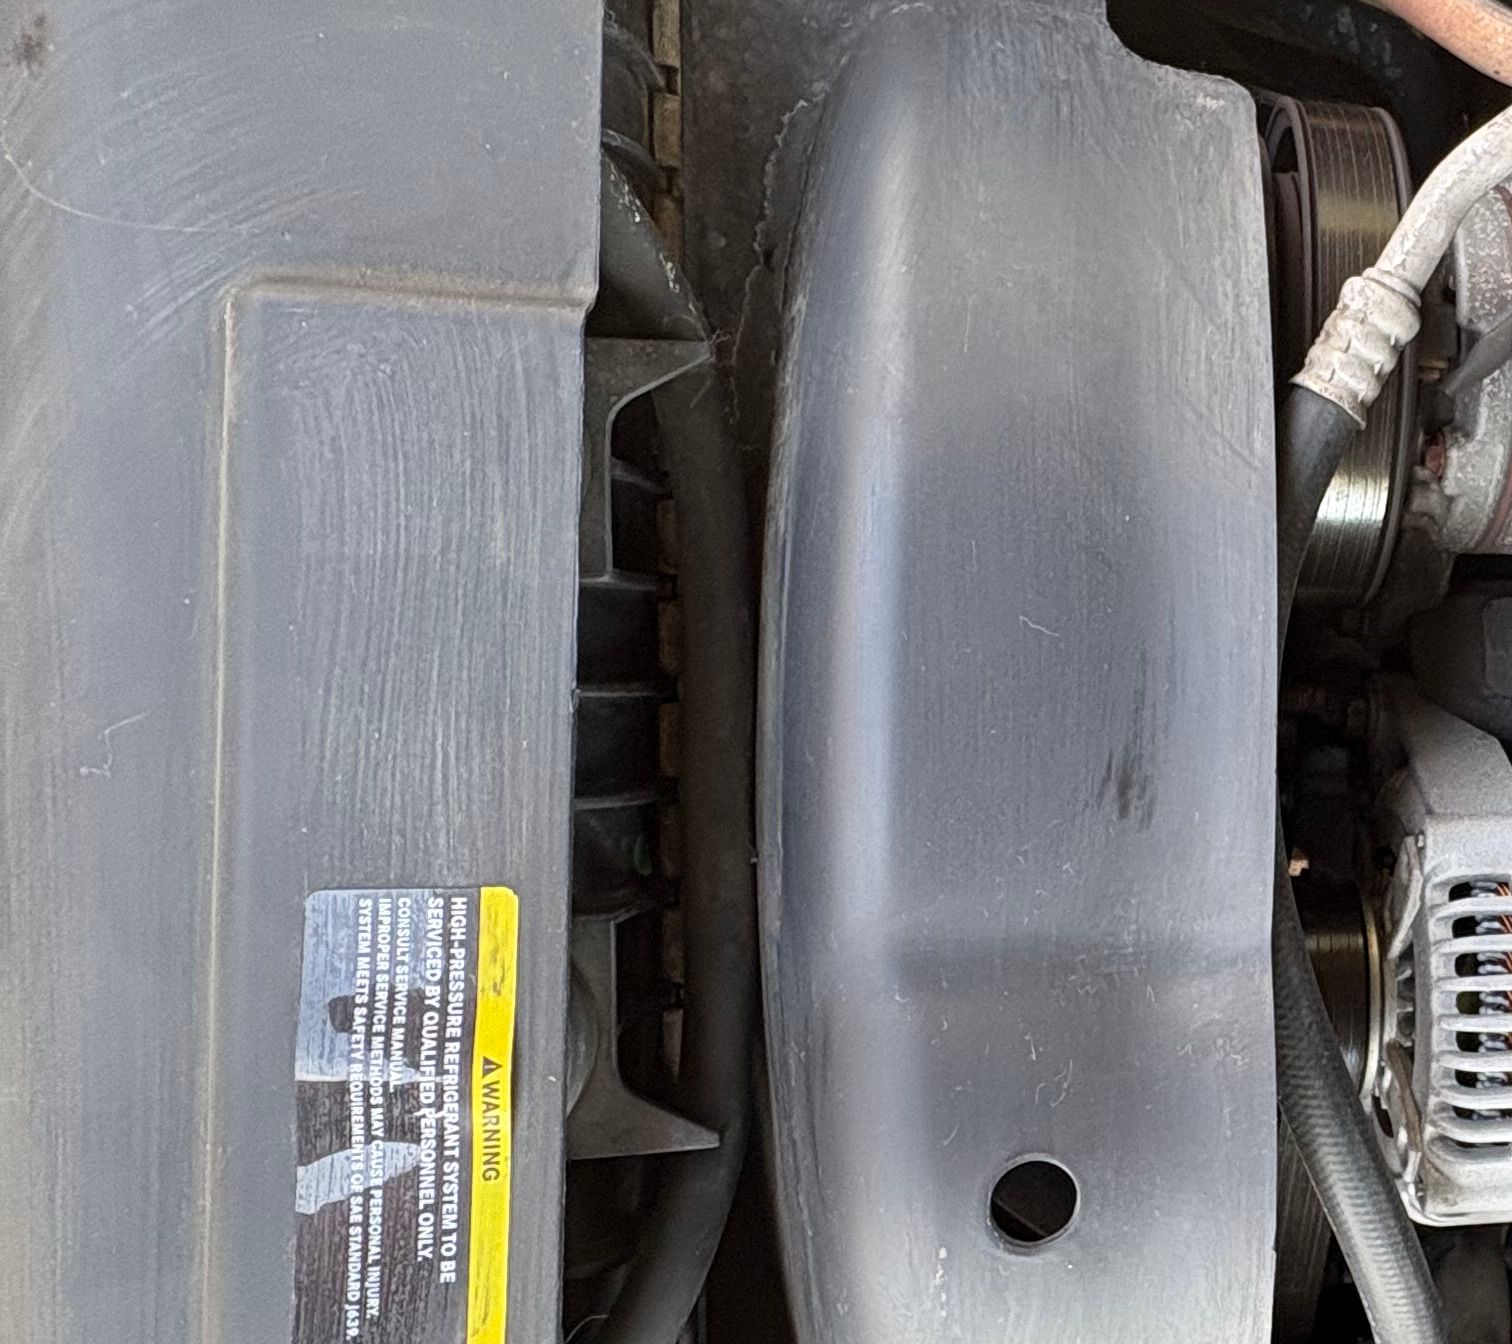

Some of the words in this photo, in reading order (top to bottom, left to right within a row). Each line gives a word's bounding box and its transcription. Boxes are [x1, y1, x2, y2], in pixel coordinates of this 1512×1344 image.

[357, 898, 373, 953] SYSTEM
[376, 898, 392, 970] IMPROPER
[396, 898, 410, 963] CONSULT
[426, 897, 444, 981] SERVICED
[355, 957, 370, 1004] MEETS
[392, 966, 408, 1025] SERVICE
[425, 985, 441, 1008] BY
[445, 897, 467, 1038] HIGH-PRESSURE
[372, 973, 389, 1032] SERVICE
[350, 1007, 367, 1059] SAFETY
[390, 1028, 405, 1093] MANUAL.
[419, 1012, 439, 1104] QUALIFIED
[370, 1036, 386, 1105] METHODS
[443, 1042, 460, 1158] REFRIGERANT
[349, 1064, 364, 1170] REQUIREMENTS
[370, 1108, 383, 1136] MAY
[482, 1080, 501, 1181] WARNING
[350, 1174, 363, 1192] OF
[370, 1140, 383, 1185] CAUSE
[419, 1108, 436, 1209] PERSONNEL
[349, 1197, 362, 1222] SAE
[442, 1161, 459, 1229] SYSTEM
[368, 1189, 382, 1264] PERSONAL
[417, 1213, 433, 1261] ONLY.
[440, 1232, 457, 1256] TO
[346, 1226, 361, 1301] STANDARD
[365, 1267, 380, 1319] INJURY.
[440, 1260, 456, 1283] BE
[345, 1305, 360, 1341] J639.
